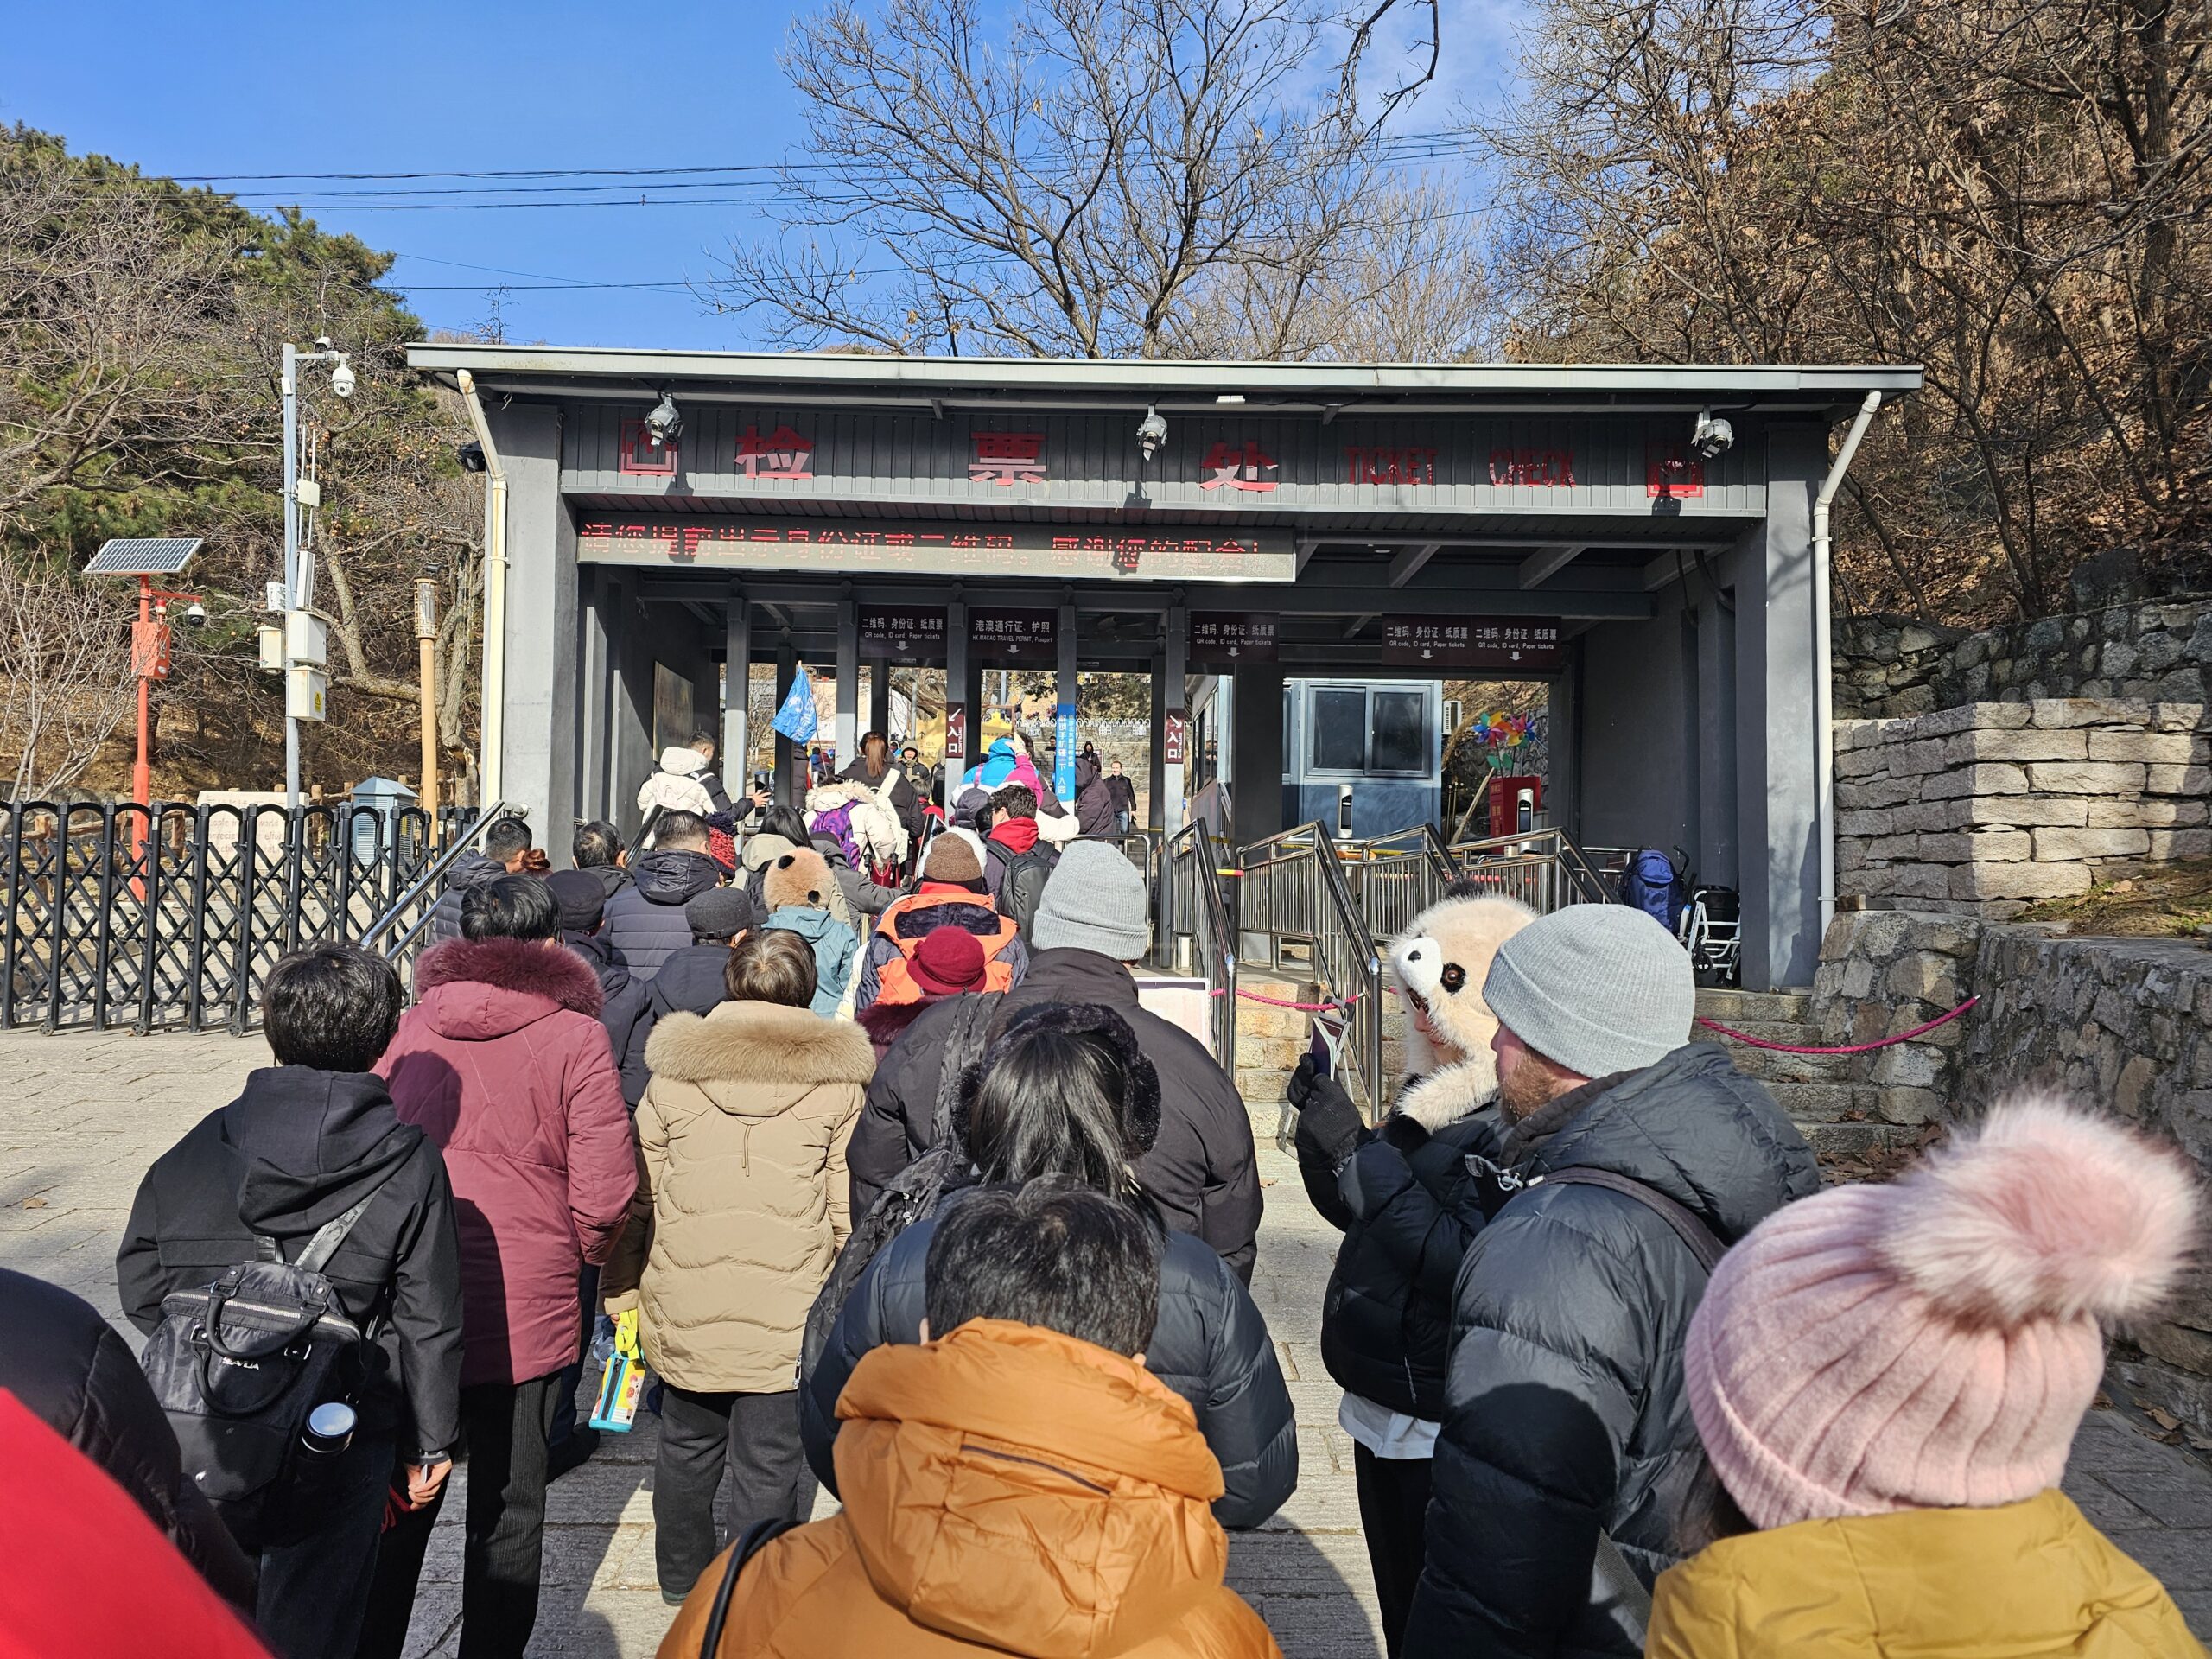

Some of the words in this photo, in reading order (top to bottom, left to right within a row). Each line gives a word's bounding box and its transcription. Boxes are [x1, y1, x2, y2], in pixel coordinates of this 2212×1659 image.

[1344, 446, 1438, 485] TICKET
[1489, 448, 1577, 488] CHECK
[862, 617, 944, 630] 二维码、身份证、纸质票
[976, 620, 1050, 633] 港澳通行证、护照
[1387, 626, 1468, 639] 二维码、身份证、纸质票
[1476, 627, 1557, 640] 二维码、身份证、纸质票
[947, 726, 959, 753] 入口
[1166, 731, 1179, 759] 入口
